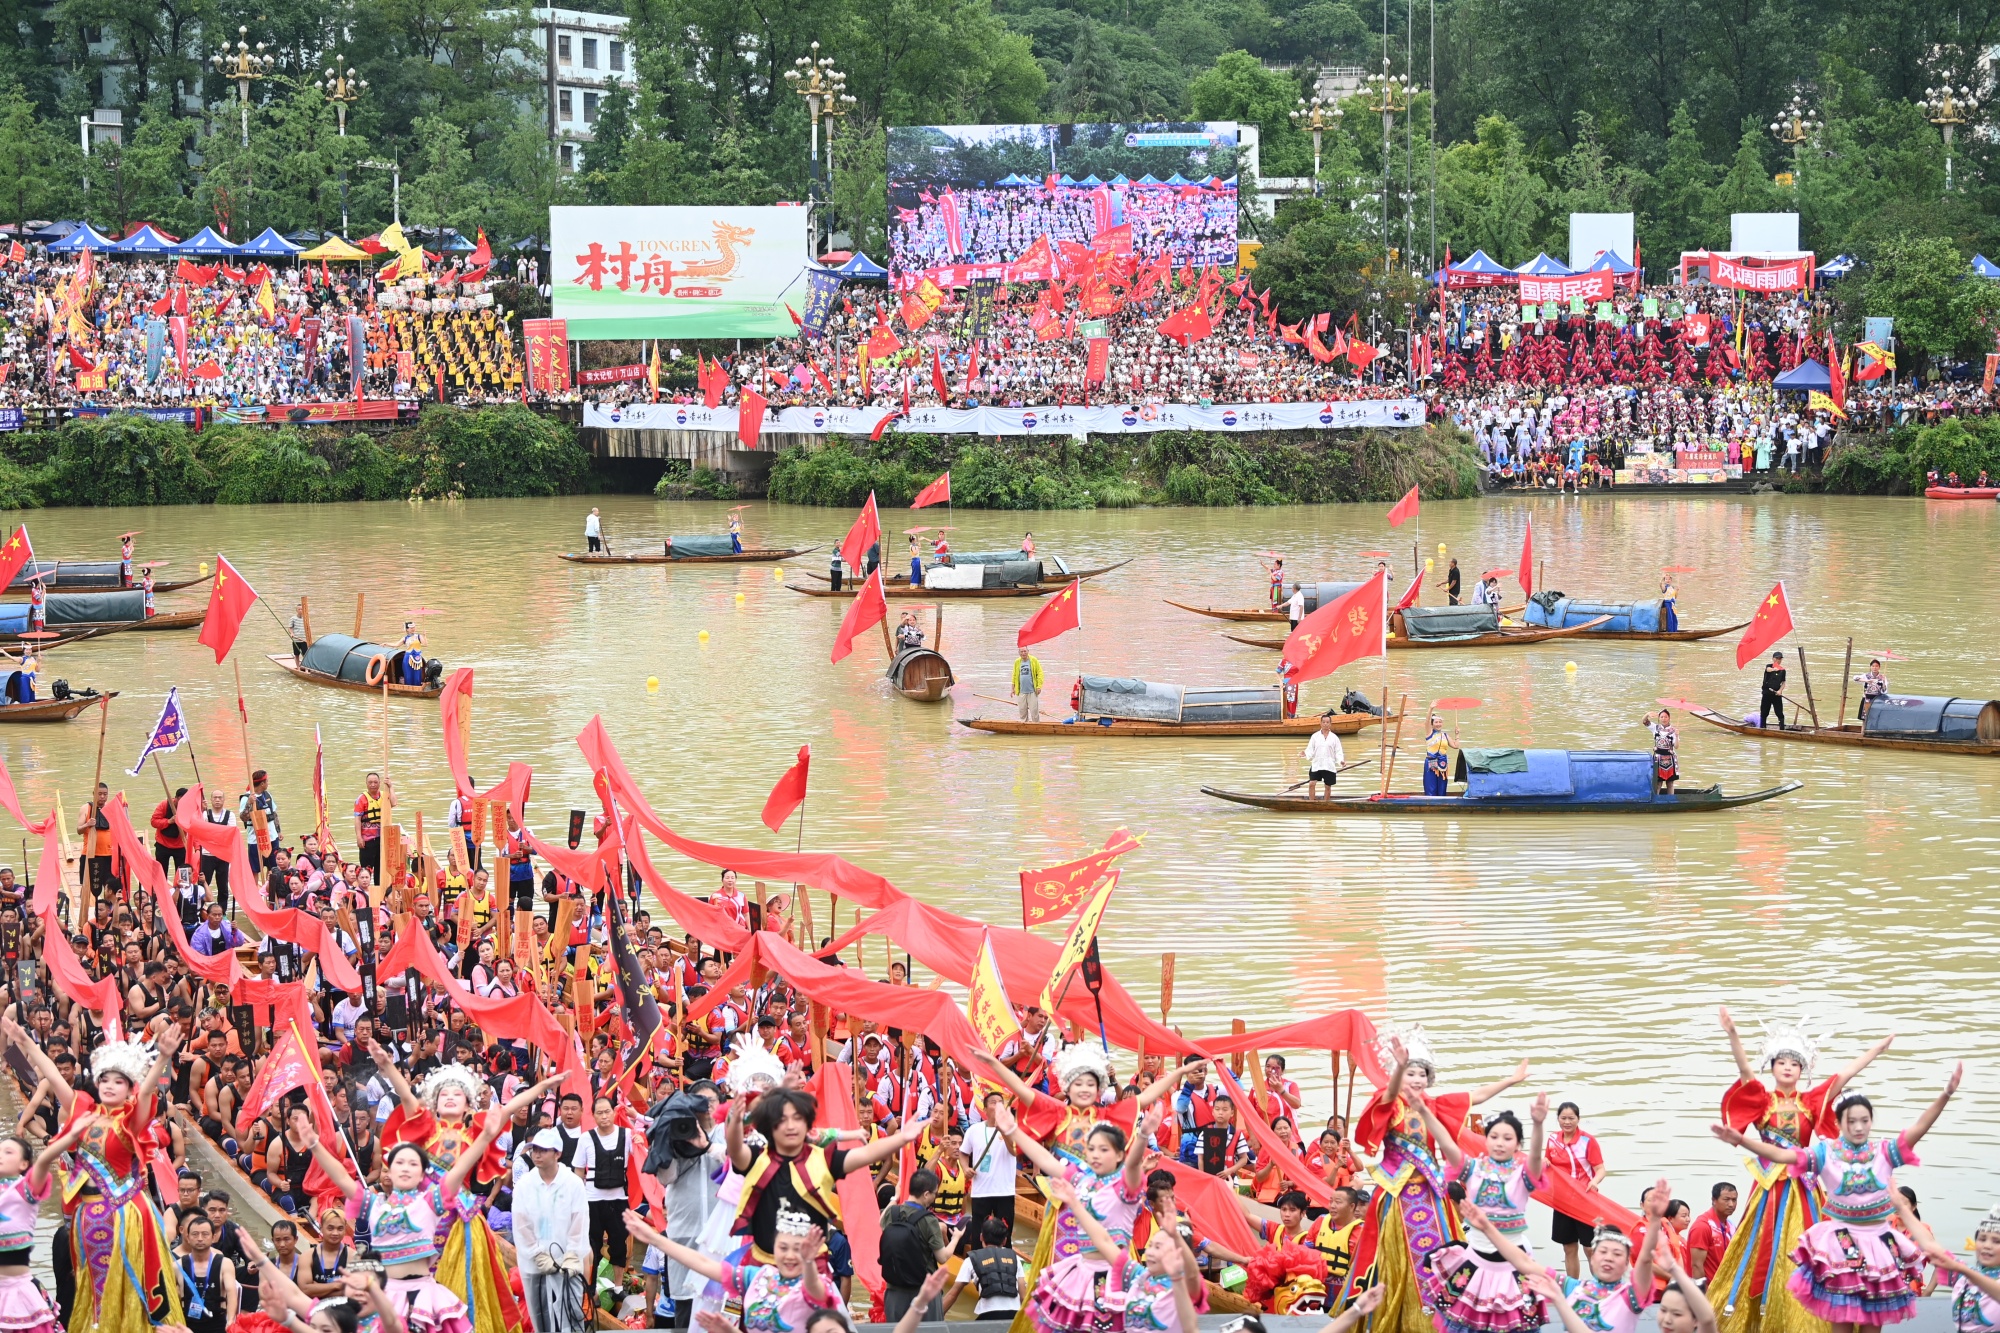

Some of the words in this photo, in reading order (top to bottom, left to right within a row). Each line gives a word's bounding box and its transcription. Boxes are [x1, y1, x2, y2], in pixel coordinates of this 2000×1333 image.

[637, 240, 711, 251] TONGREN
[573, 241, 679, 296] 村舟
[1717, 260, 1798, 289] 风调雨顺
[1520, 278, 1603, 301] 国泰民安
[1688, 322, 1707, 338] 油
[80, 375, 104, 389] 加油
